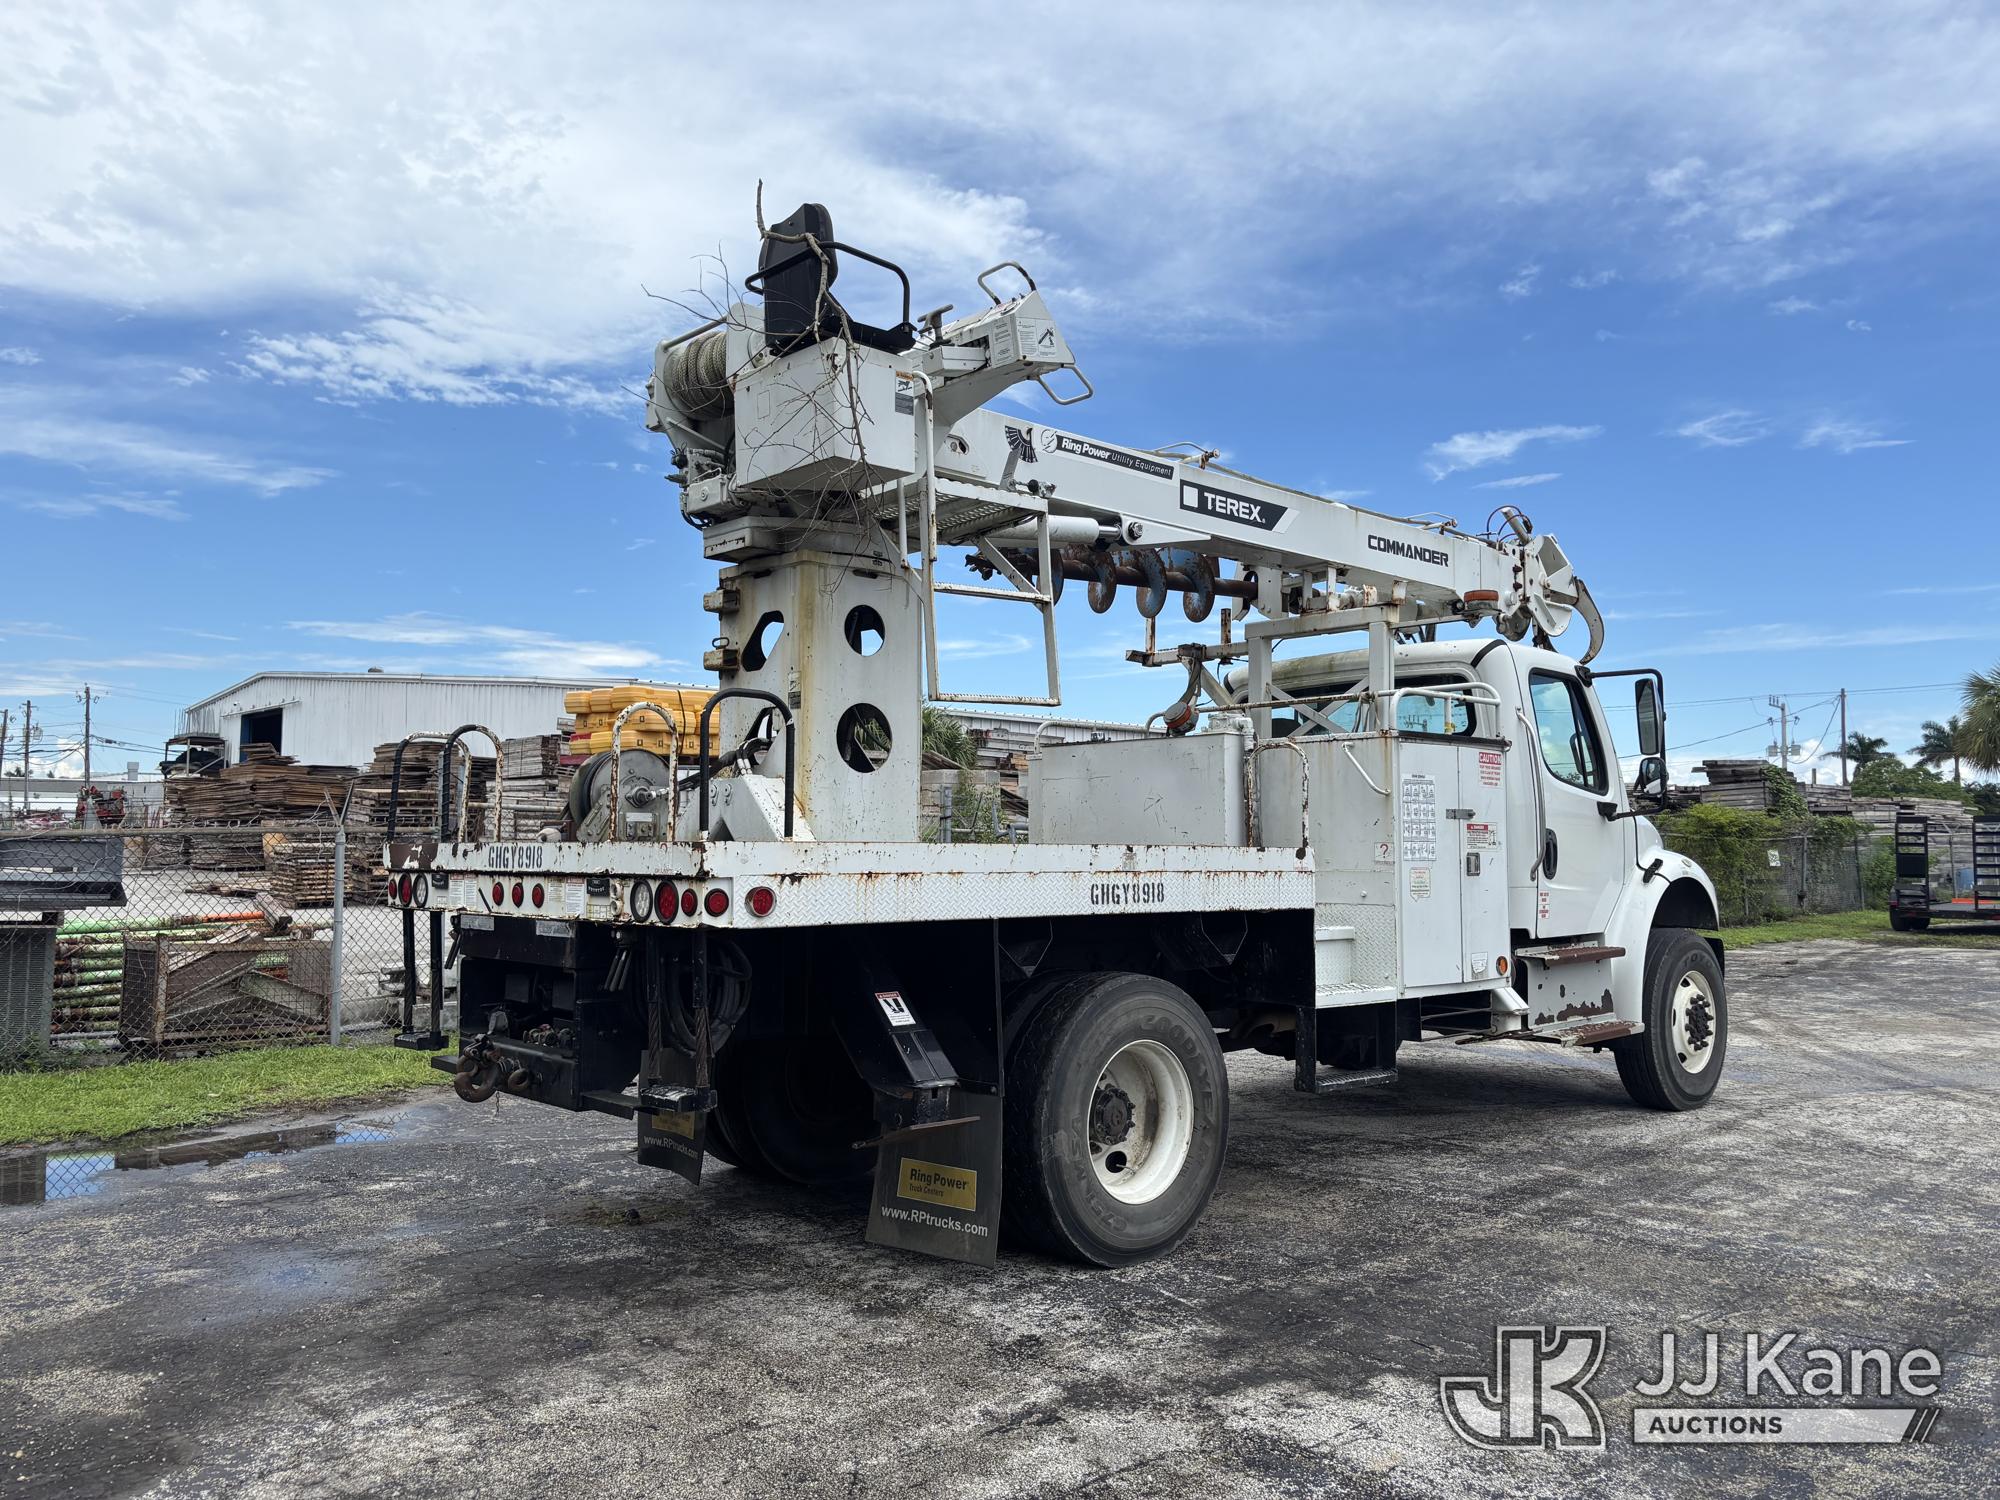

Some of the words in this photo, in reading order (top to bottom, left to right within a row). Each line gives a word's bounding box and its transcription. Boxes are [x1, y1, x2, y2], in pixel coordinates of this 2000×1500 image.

[1061, 438, 1082, 454] Ring
[1082, 445, 1111, 460] Power
[1111, 452, 1134, 468] Utility
[1135, 459, 1171, 477] Equipment
[1204, 491, 1262, 523] TEREX
[1368, 534, 1449, 568] COMMANDER
[488, 845, 543, 869] GHGY8918
[1090, 882, 1165, 905] GHGY8918
[909, 1183, 923, 1193] Truck
[923, 1185, 944, 1198] Centers
[910, 1168, 932, 1186] Ring
[933, 1172, 968, 1191] Power
[881, 1205, 989, 1238] www.RPtrucks.com
